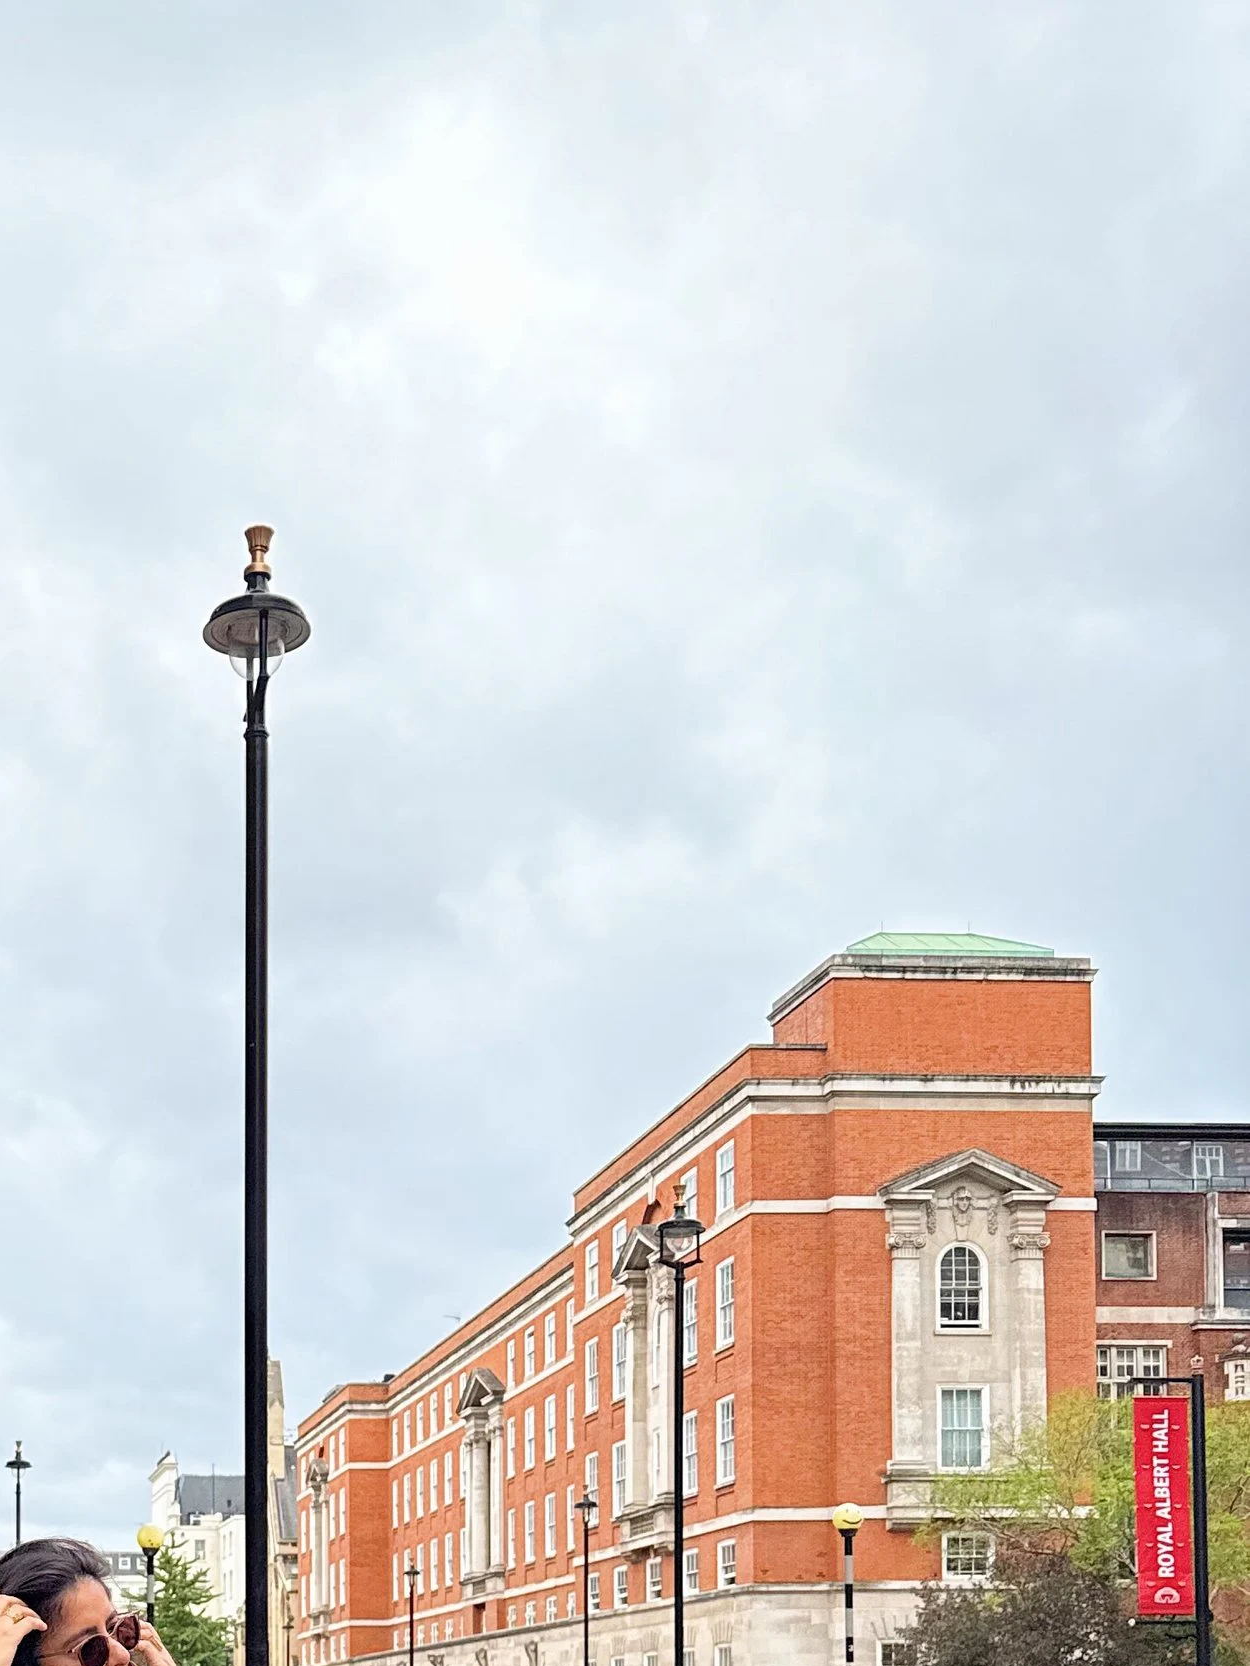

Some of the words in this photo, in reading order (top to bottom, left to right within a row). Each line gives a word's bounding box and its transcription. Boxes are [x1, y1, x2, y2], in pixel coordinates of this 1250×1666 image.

[1152, 1409, 1169, 1453] HALL
[1152, 1456, 1172, 1520] ALBERT
[1157, 1522, 1175, 1578] ROYAL
